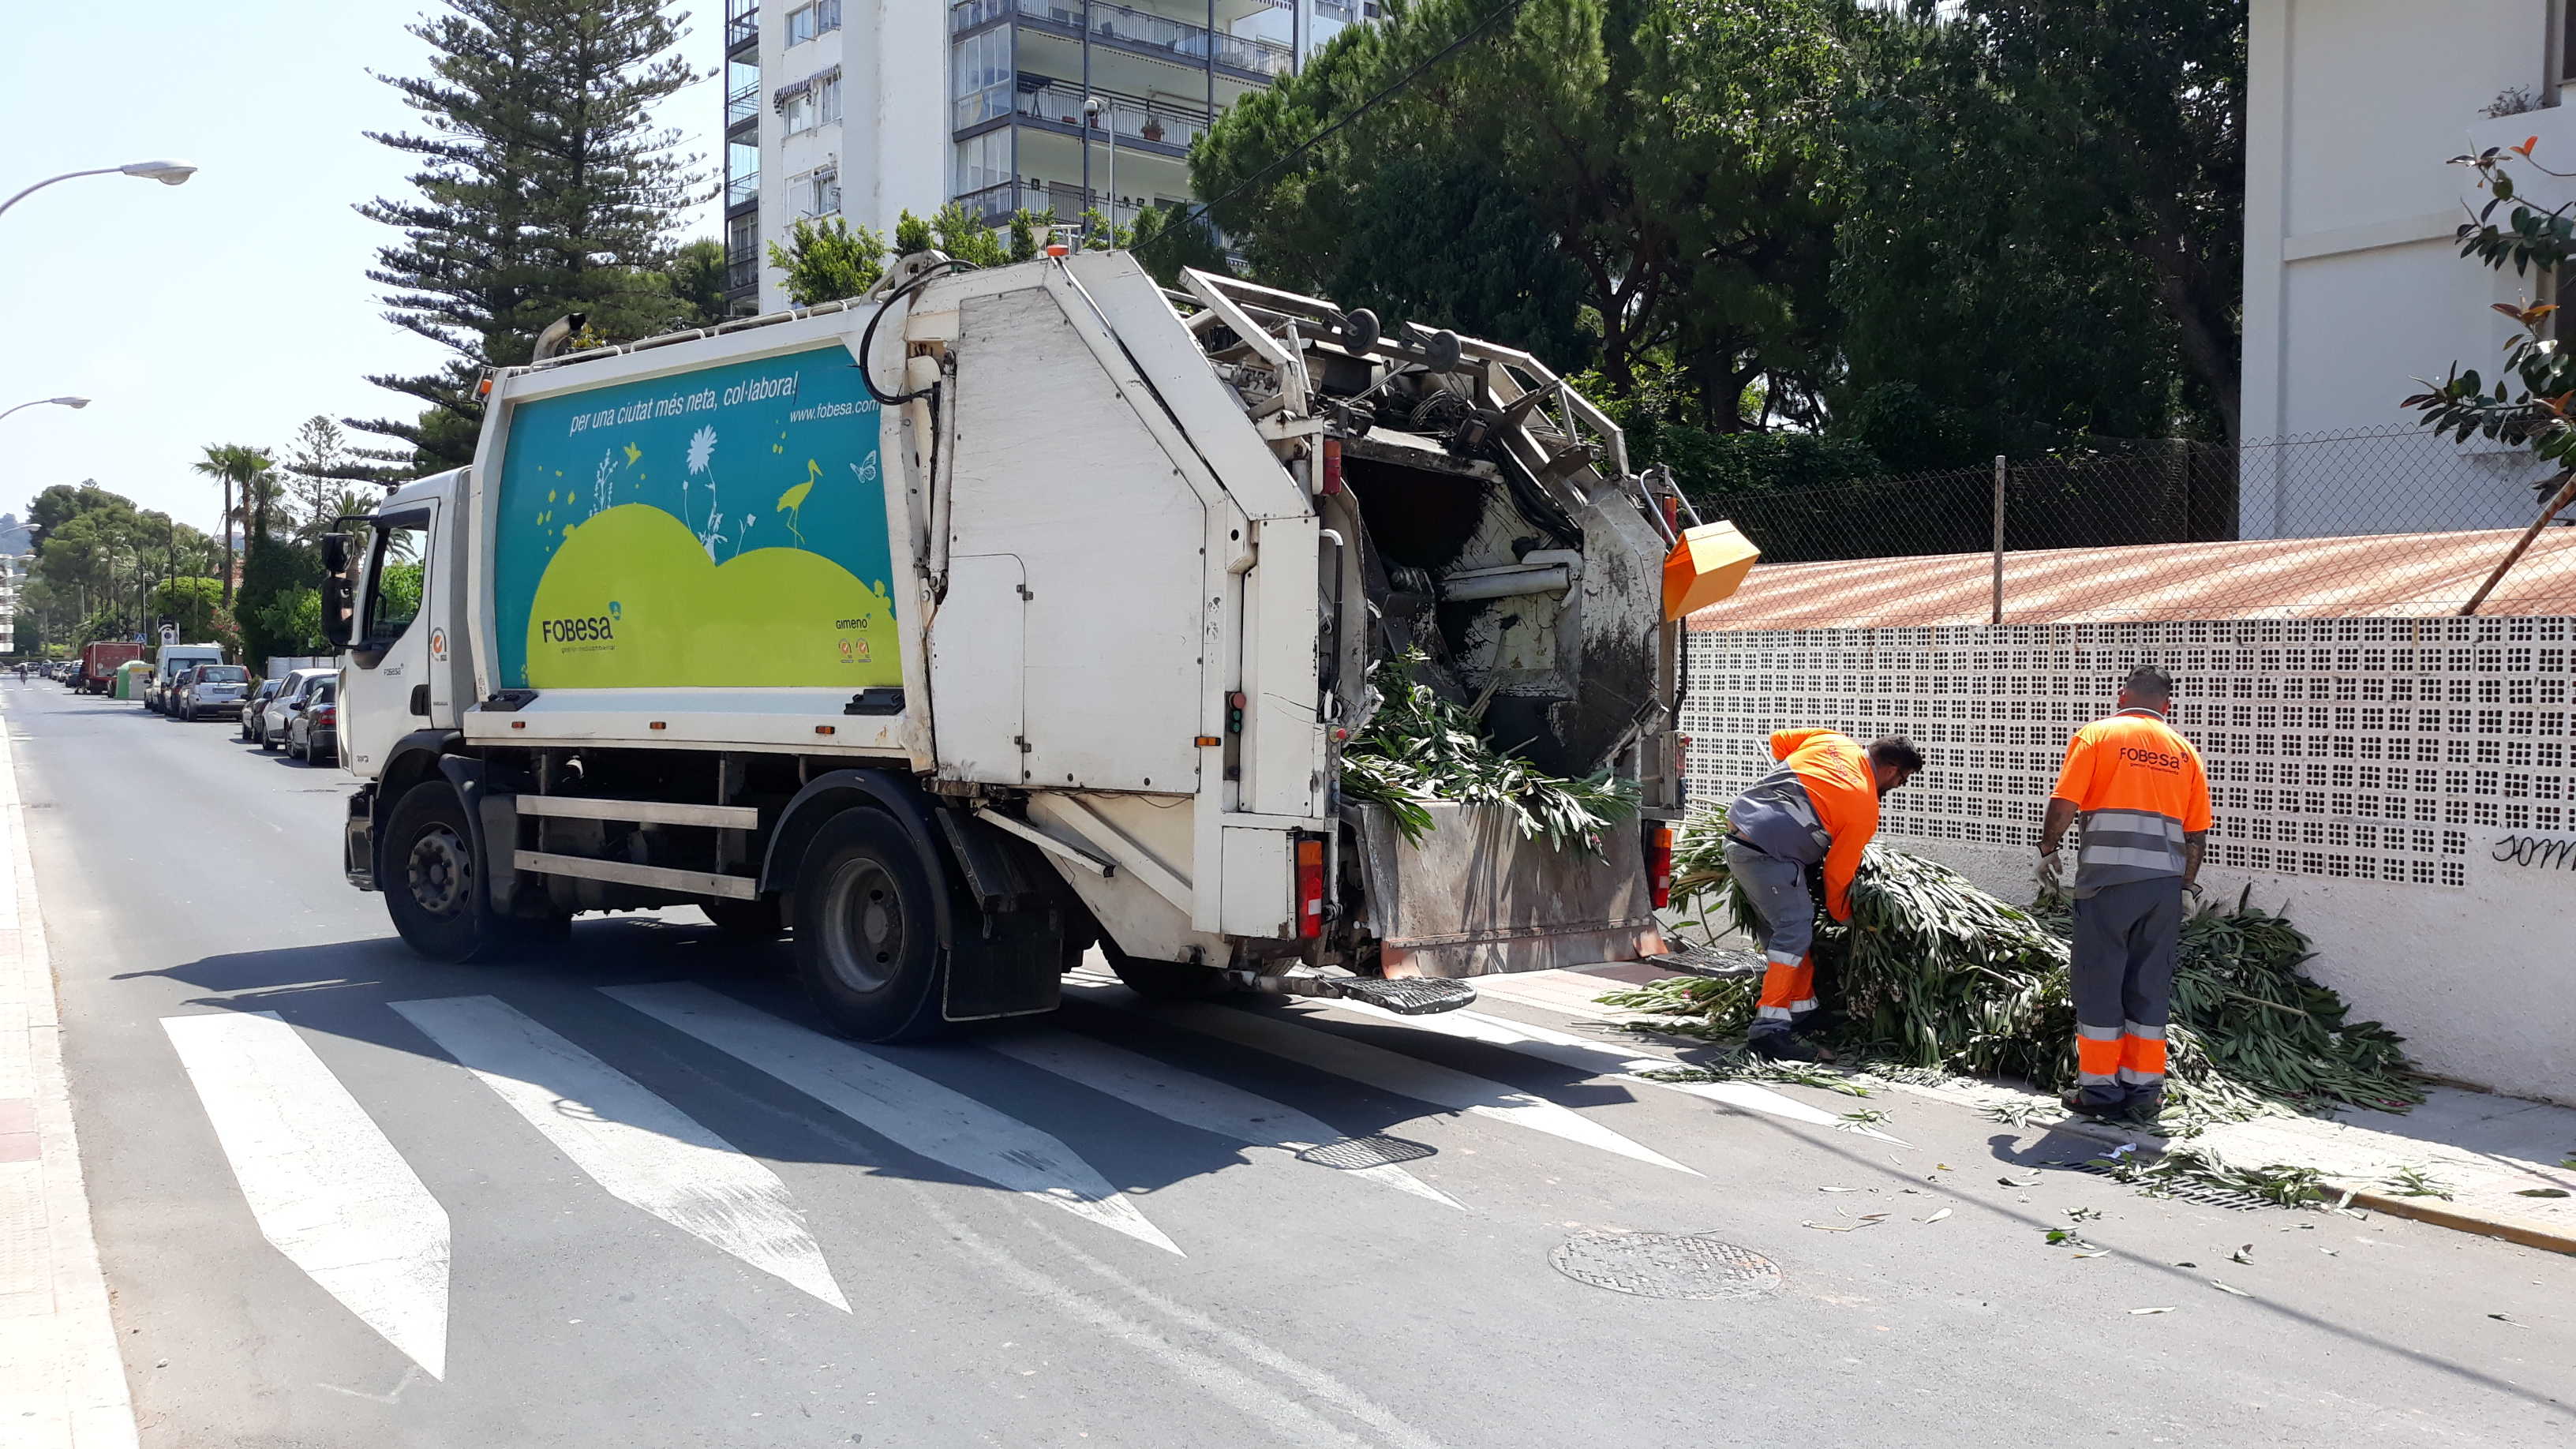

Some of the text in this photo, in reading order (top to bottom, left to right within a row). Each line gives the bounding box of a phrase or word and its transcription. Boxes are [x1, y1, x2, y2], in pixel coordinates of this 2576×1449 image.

[570, 370, 799, 437] per una ciutat més neta, col·labora!
[790, 399, 880, 423] www.fobesa.com
